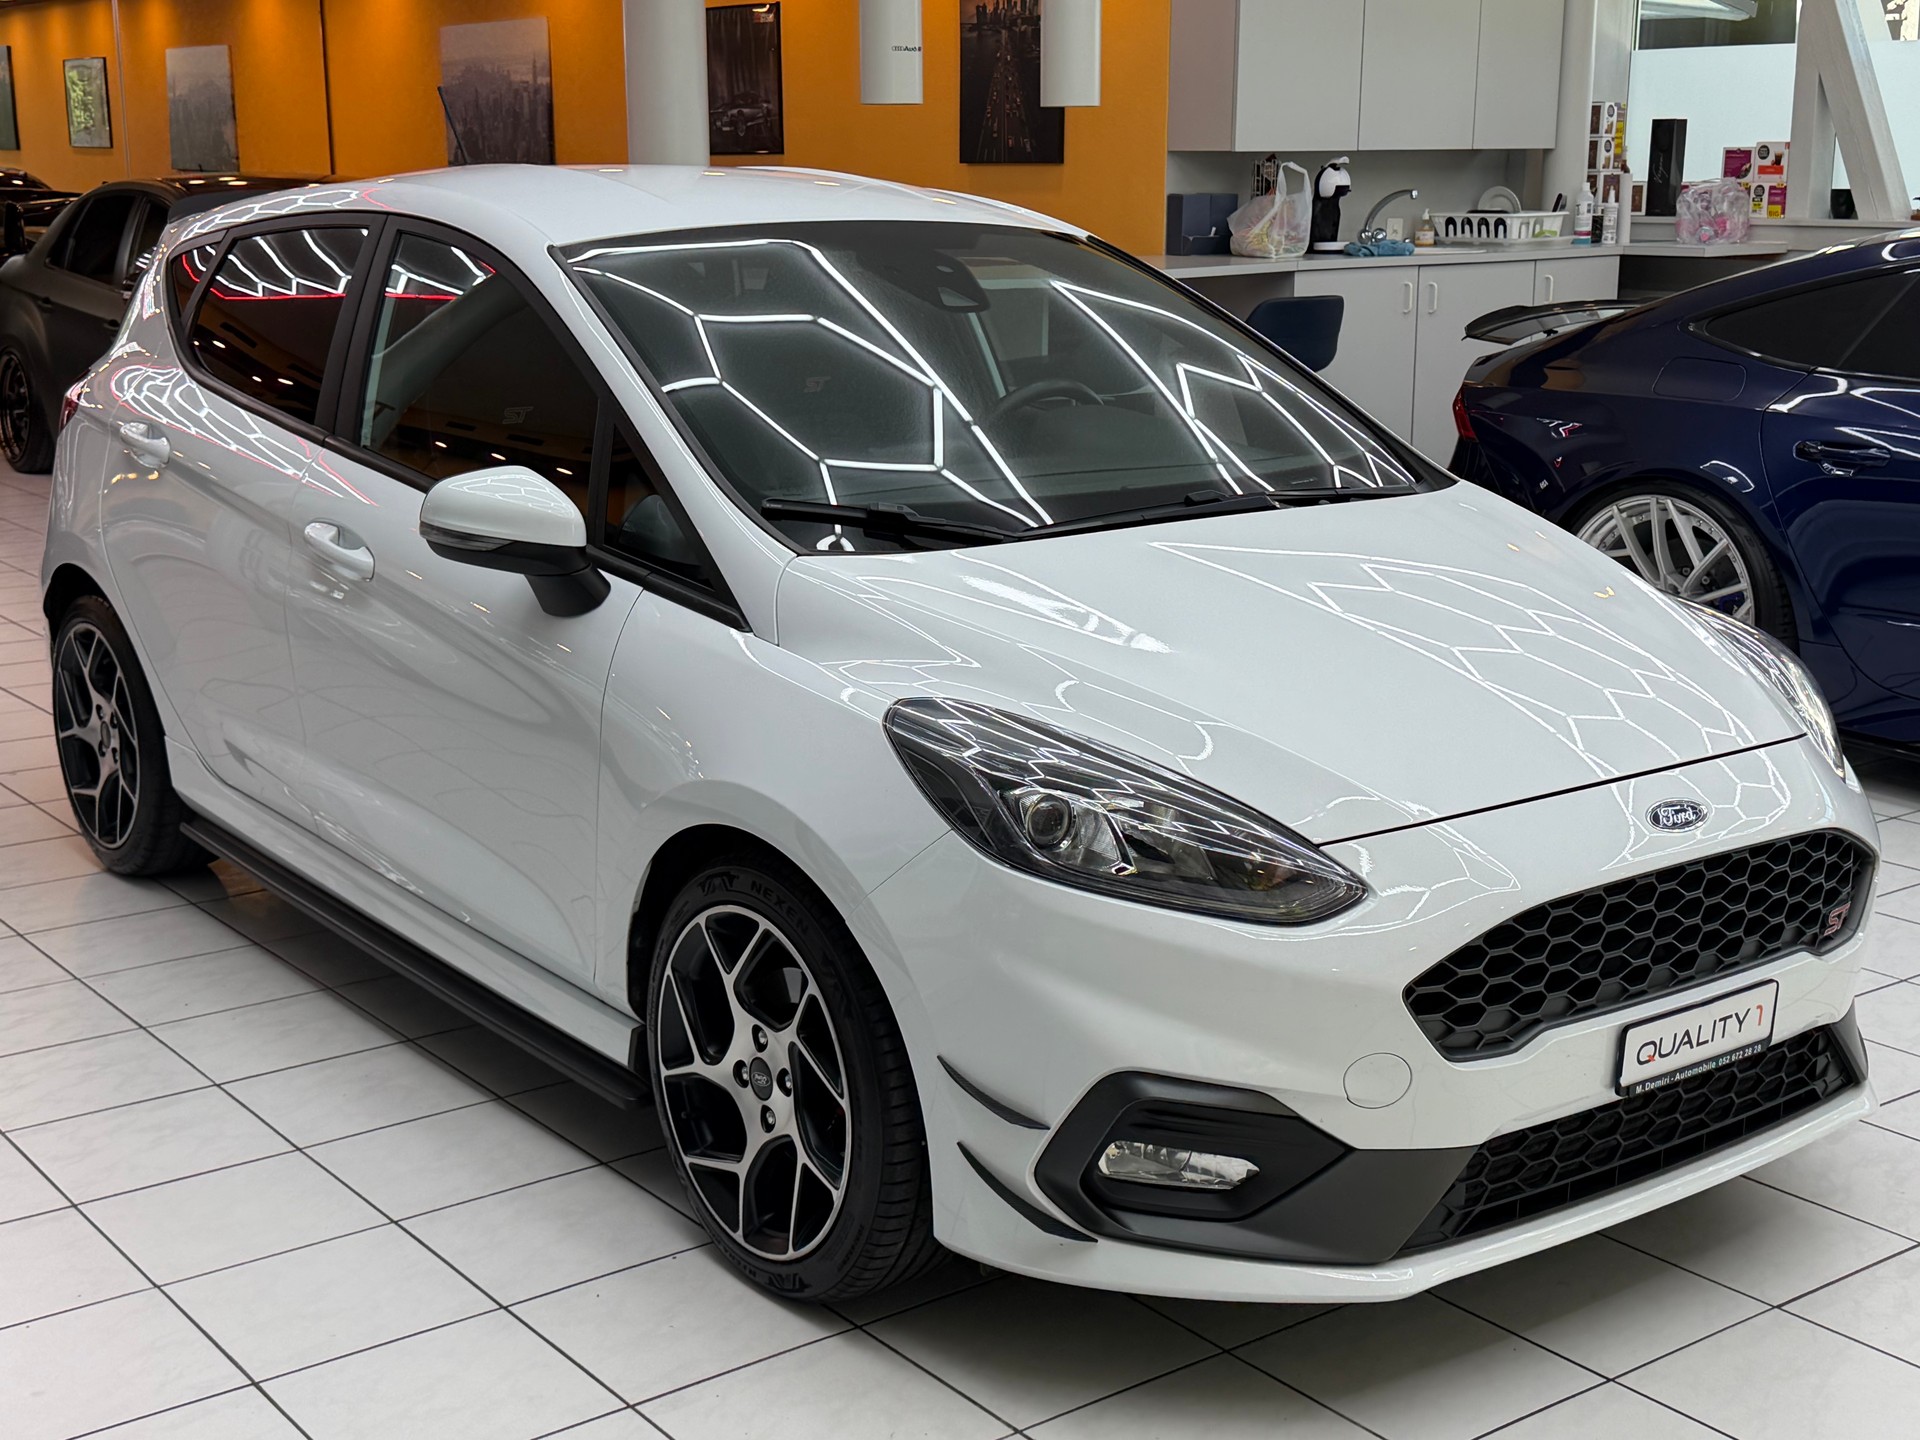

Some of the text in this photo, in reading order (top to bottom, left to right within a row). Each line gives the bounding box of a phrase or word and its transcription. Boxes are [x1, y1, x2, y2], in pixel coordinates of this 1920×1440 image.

[502, 406, 534, 424] ST
[1660, 804, 1696, 827] Ford
[750, 879, 809, 932] NEXEN
[1823, 901, 1851, 936] ST
[1636, 1004, 1764, 1066] QUALITY 1
[1645, 1075, 1670, 1091] Demiri
[1674, 1061, 1716, 1081] Automobile
[1718, 1055, 1730, 1067] 052
[1731, 1050, 1743, 1062] 672
[1744, 1047, 1753, 1057] 28
[1753, 1044, 1762, 1053] 28
